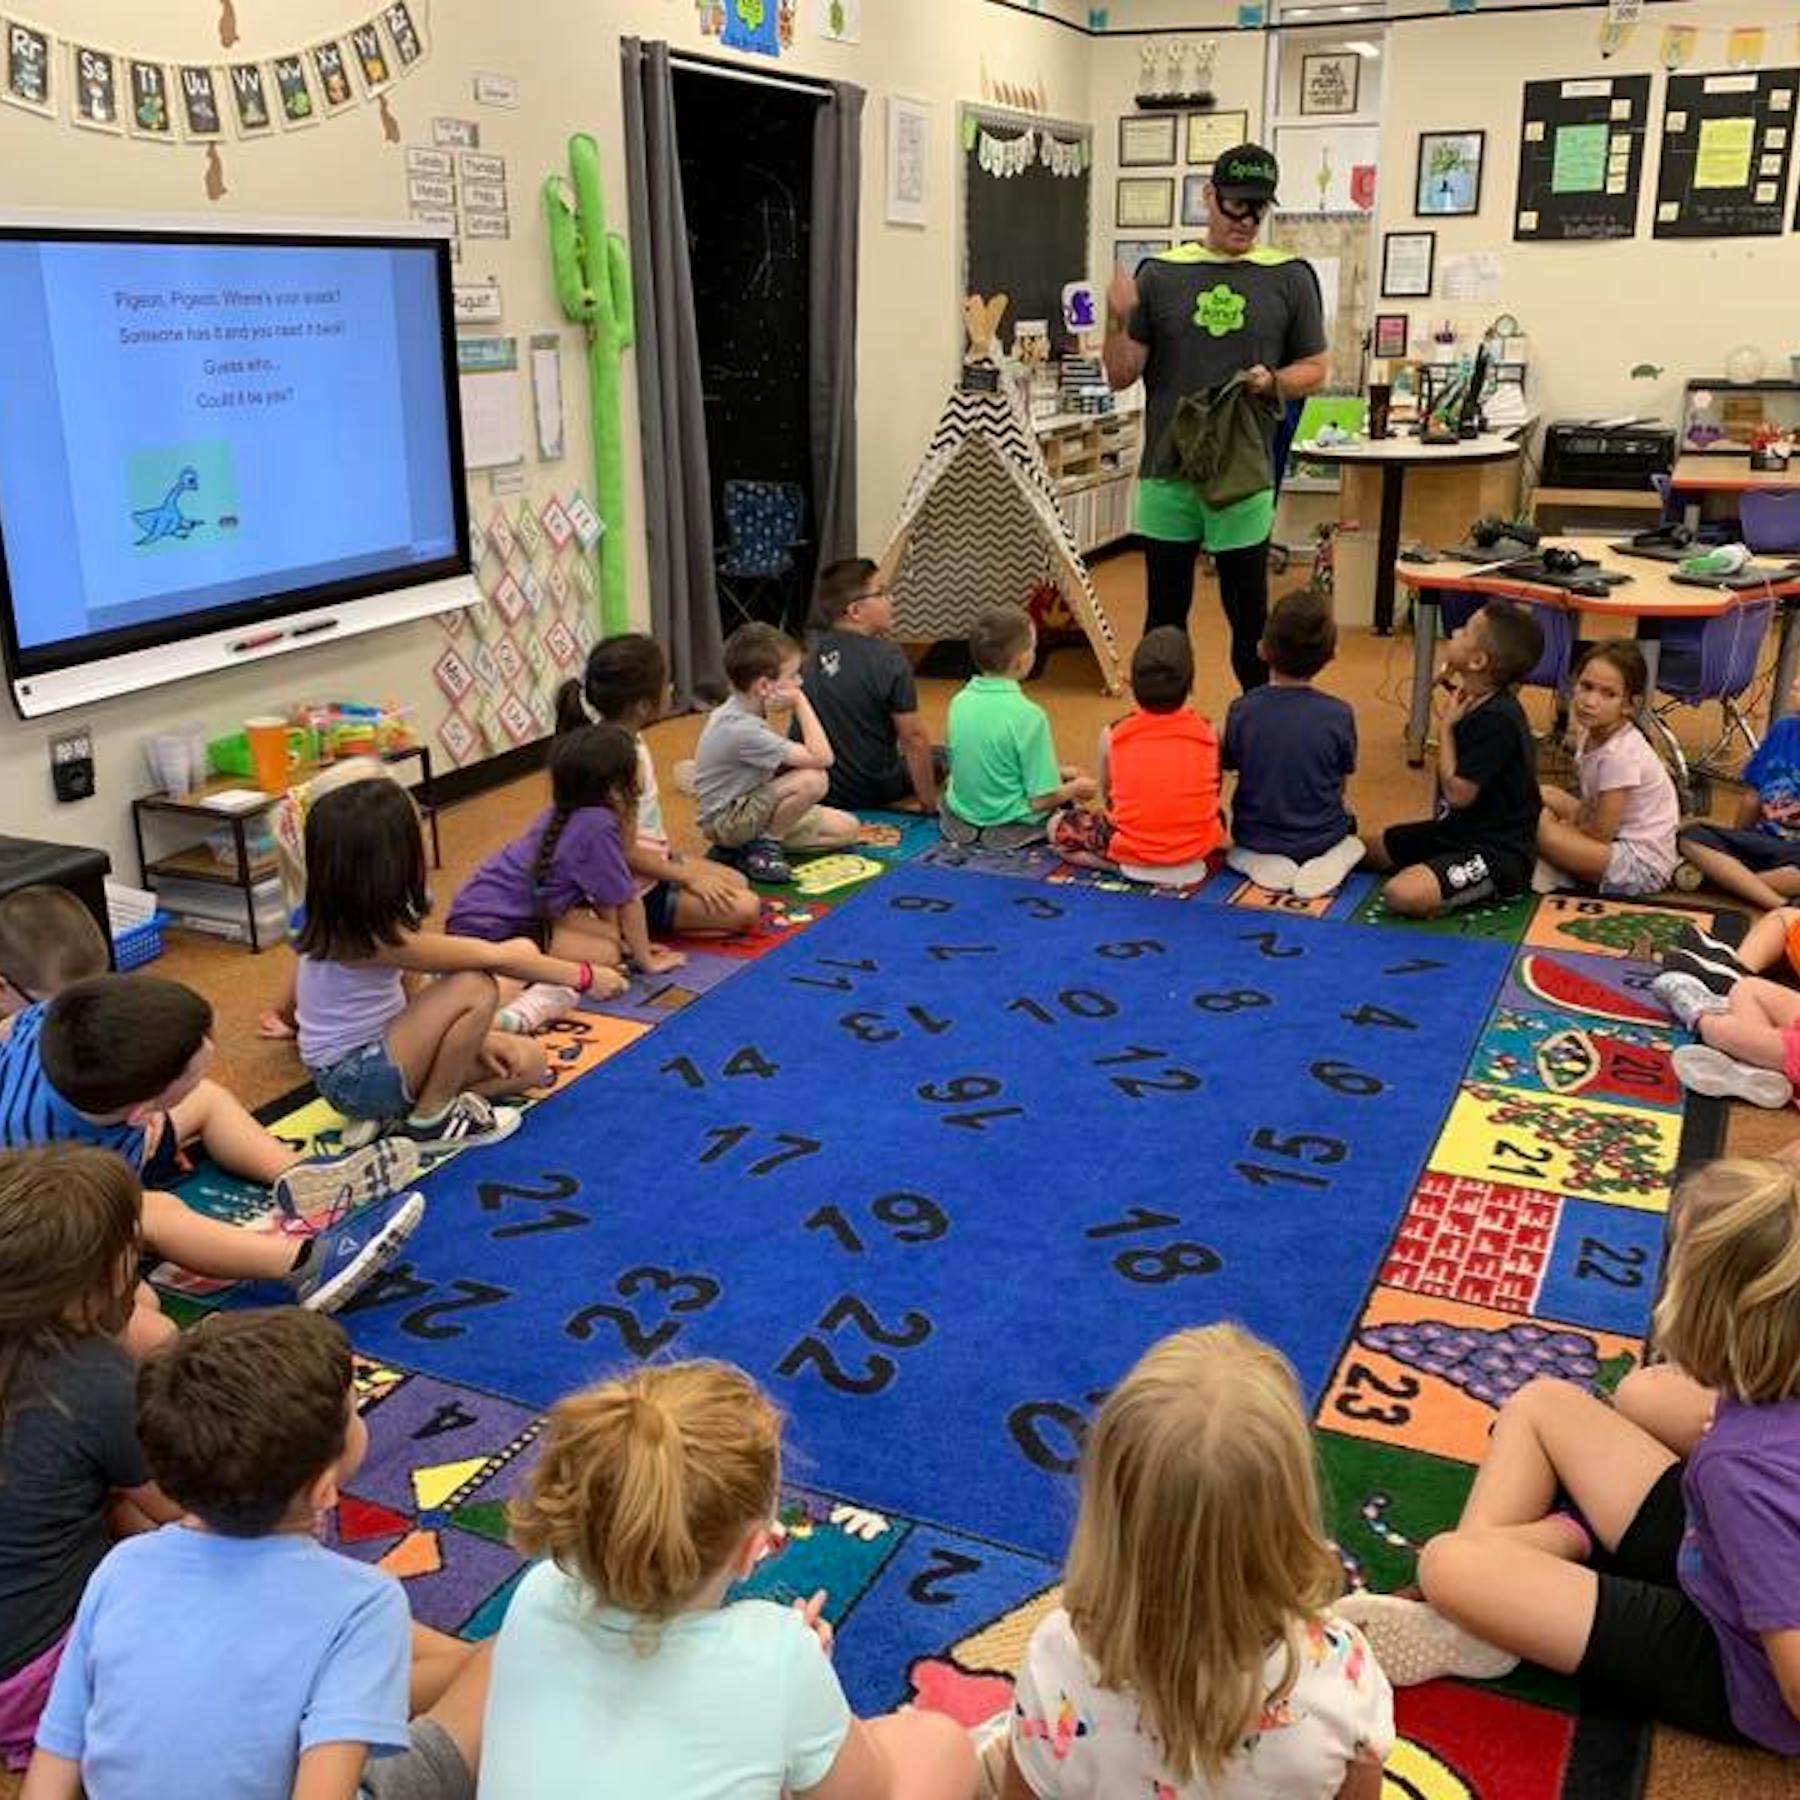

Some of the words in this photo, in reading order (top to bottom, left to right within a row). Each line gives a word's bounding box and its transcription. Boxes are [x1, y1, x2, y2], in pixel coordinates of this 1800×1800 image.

[81, 51, 108, 80] Ss
[1238, 931, 1303, 958] 2
[1005, 987, 1120, 1024] 10
[1195, 989, 1272, 1014] 8
[1340, 1003, 1418, 1030] 4
[660, 1045, 782, 1088] 14
[1092, 1046, 1203, 1098] 12
[1611, 1051, 1668, 1087] 20
[698, 1123, 822, 1178] 17
[1234, 1126, 1348, 1190] 15
[1488, 1139, 1553, 1179] 21
[803, 1192, 950, 1254] 19
[1084, 1207, 1223, 1284] 18
[1574, 1236, 1648, 1289] 22
[564, 1266, 722, 1360] 23
[775, 1293, 934, 1397] 22
[1335, 1362, 1421, 1427] 23
[906, 1548, 982, 1604] 2
